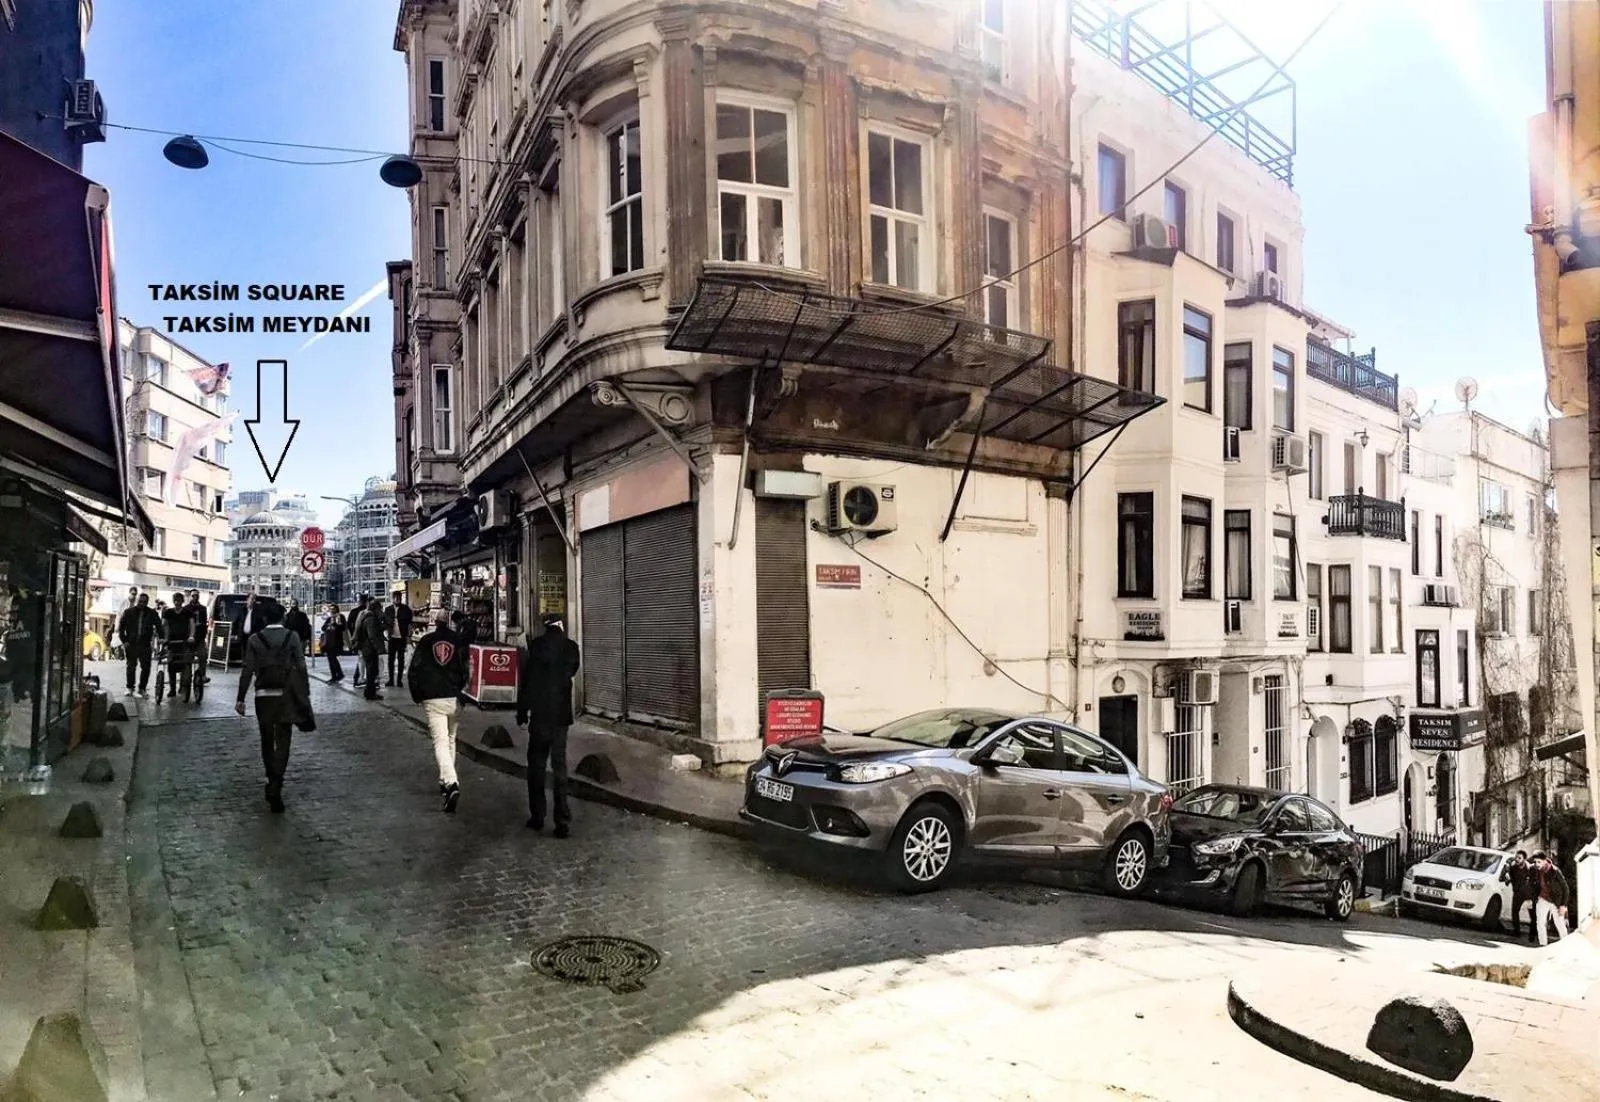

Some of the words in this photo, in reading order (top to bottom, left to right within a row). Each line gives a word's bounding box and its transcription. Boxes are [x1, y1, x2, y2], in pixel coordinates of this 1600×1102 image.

[303, 534, 323, 544] DUR
[1128, 612, 1161, 621] EAGLE
[1421, 728, 1449, 736] SEVEN
[1413, 738, 1459, 748] RESIDENCE
